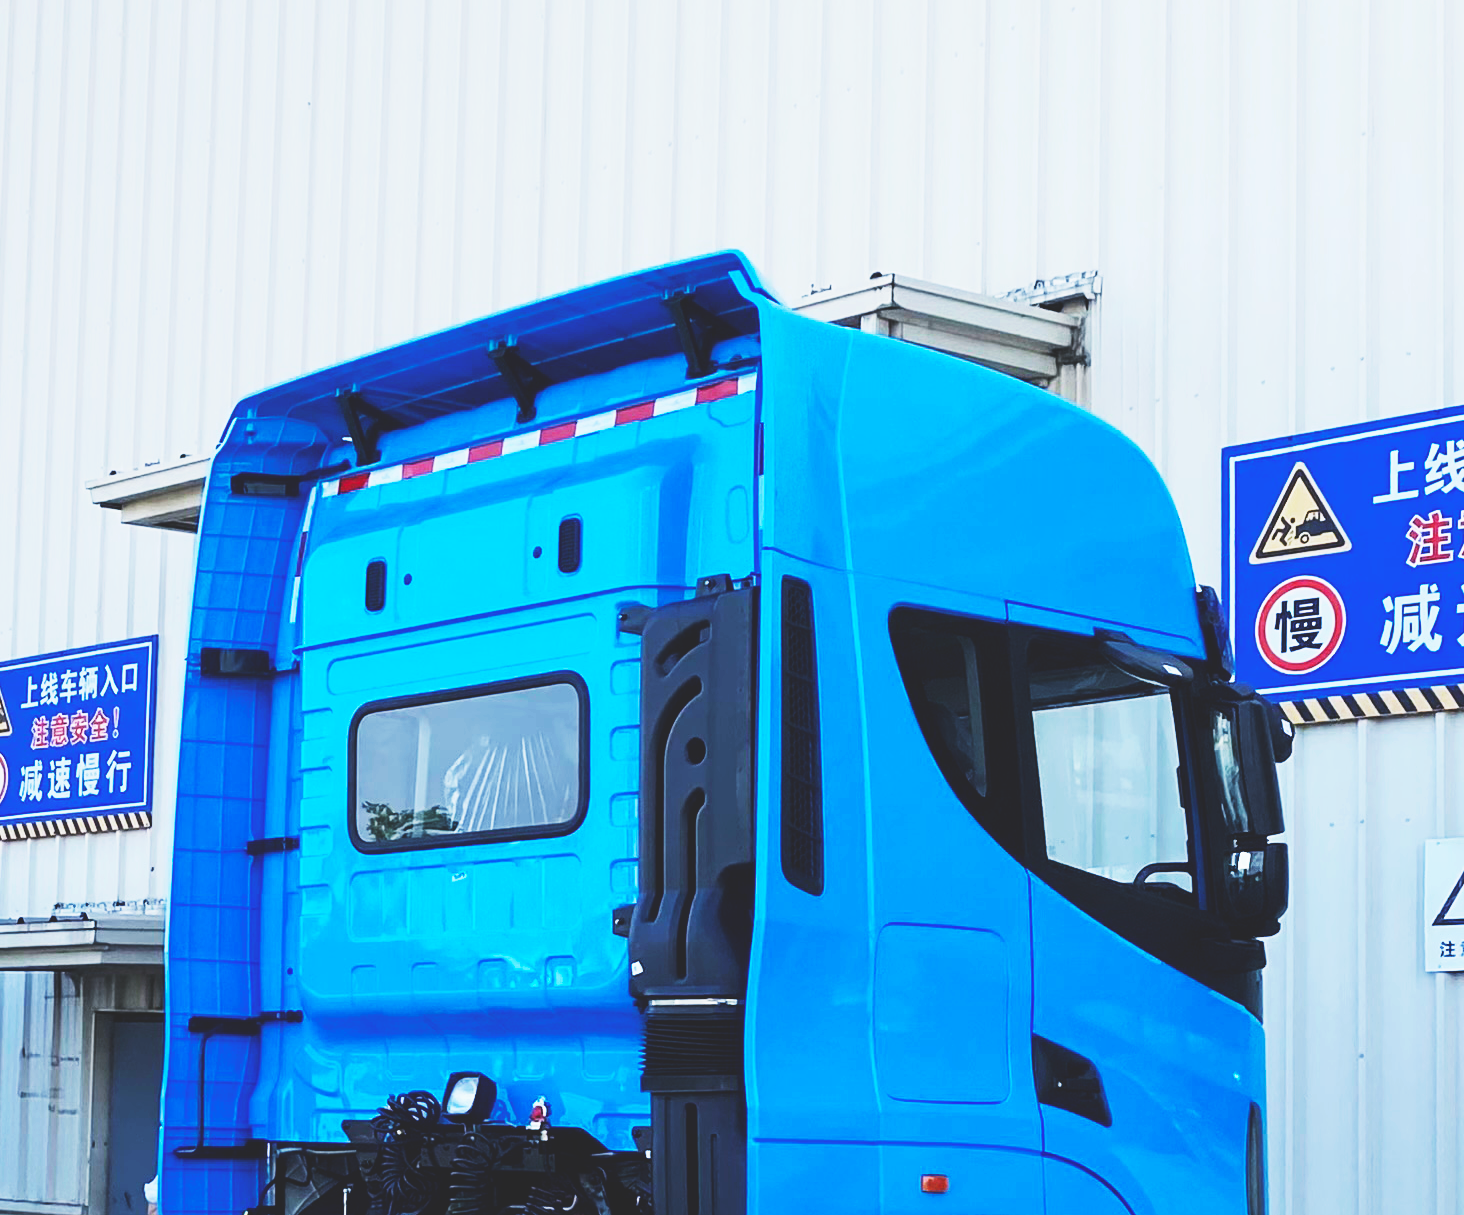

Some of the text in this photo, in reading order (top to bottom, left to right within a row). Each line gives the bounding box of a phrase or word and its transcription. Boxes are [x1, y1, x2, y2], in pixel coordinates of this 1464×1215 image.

[1373, 439, 1464, 504] 上线
[1406, 509, 1464, 568] 注
[1274, 597, 1323, 654] 慢
[1379, 583, 1464, 655] 减
[20, 663, 138, 709] 上线车辆入口
[19, 750, 132, 802] 减速慢行
